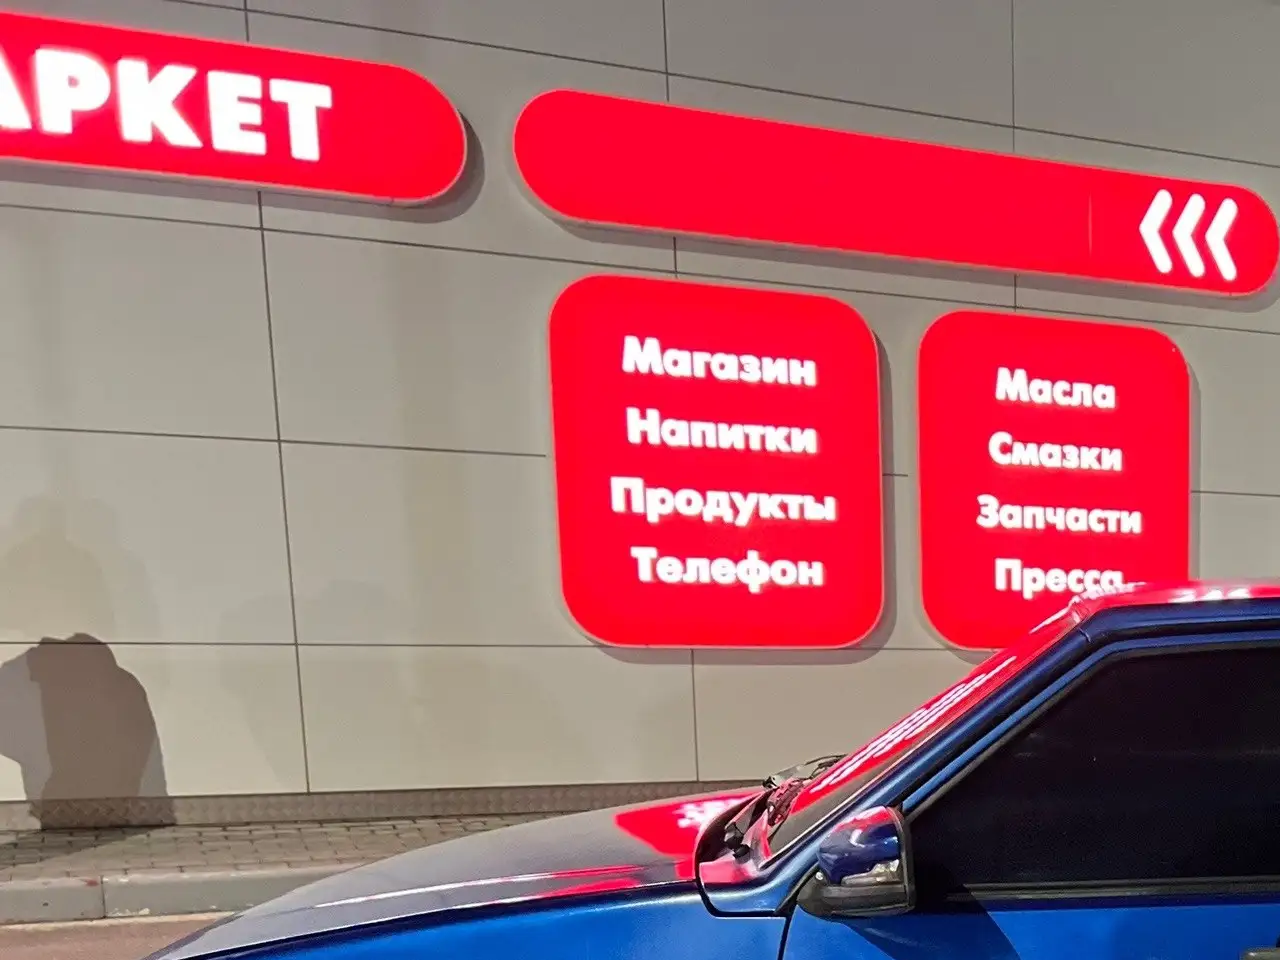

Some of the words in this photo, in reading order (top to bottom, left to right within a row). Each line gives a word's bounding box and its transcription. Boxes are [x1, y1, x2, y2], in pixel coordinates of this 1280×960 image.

[622, 335, 817, 387] Магазин
[995, 367, 1116, 409] Масла
[626, 407, 818, 454] Напитки
[988, 431, 1123, 472] Смазки
[610, 476, 837, 527] Продукты
[976, 494, 1142, 534] Запчасти
[630, 546, 824, 594] Телефон
[995, 558, 1124, 600] Пресса
